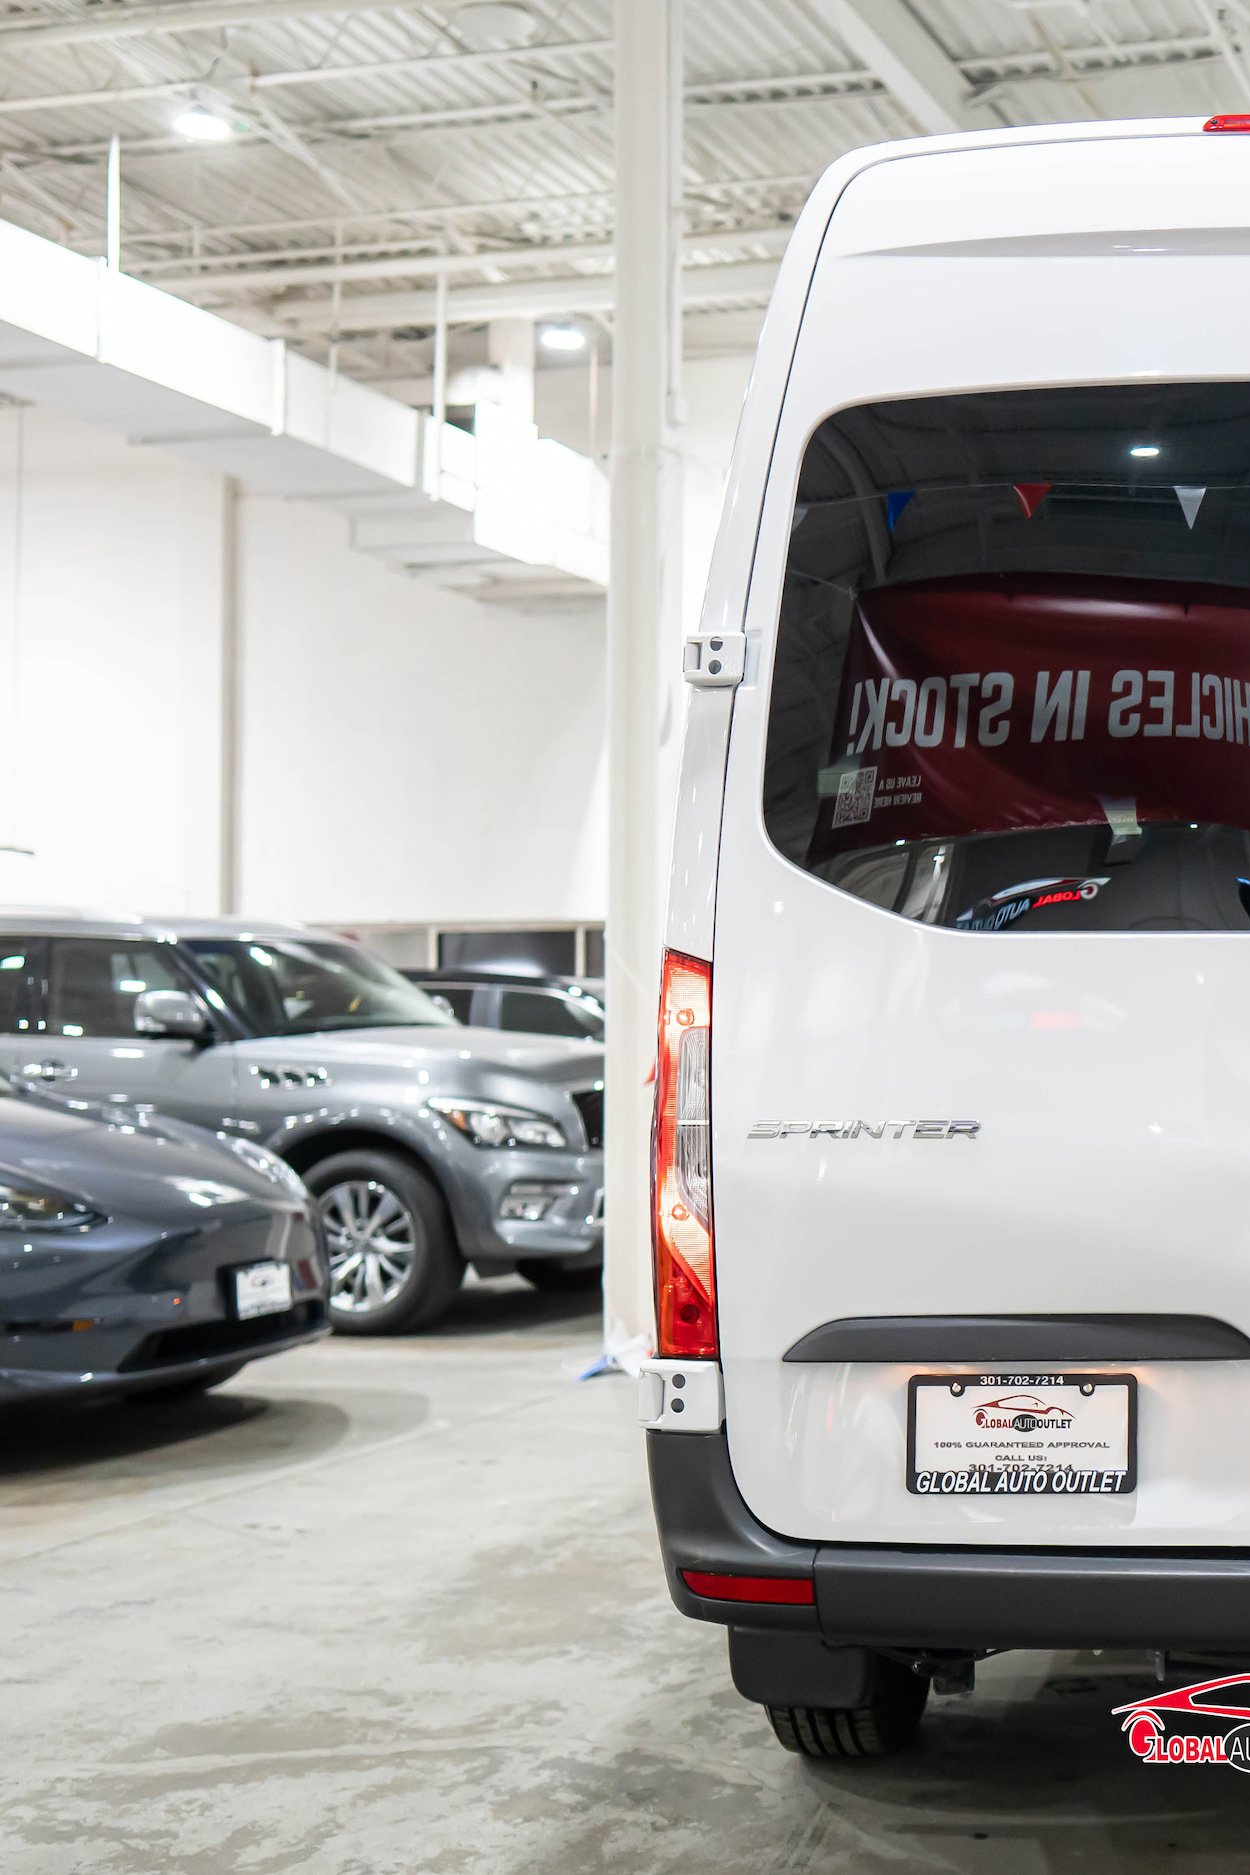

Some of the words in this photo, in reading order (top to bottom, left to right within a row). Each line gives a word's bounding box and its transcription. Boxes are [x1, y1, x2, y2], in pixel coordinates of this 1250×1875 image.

[746, 1119, 982, 1139] SPRINTER
[980, 1375, 1065, 1386] 301-702-7214
[974, 1411, 1013, 1429] GLOBAL
[1012, 1418, 1038, 1429] AUTO
[1037, 1418, 1072, 1429] OUTLET
[933, 1441, 963, 1449] 100%
[965, 1441, 1044, 1449] GUARANTEED
[1047, 1441, 1110, 1449] APPROVAL
[968, 1464, 1074, 1473] 301-702-7214
[916, 1471, 992, 1493] GLOBAL
[995, 1471, 1049, 1493] AUTO
[1051, 1471, 1126, 1493] OUTLET
